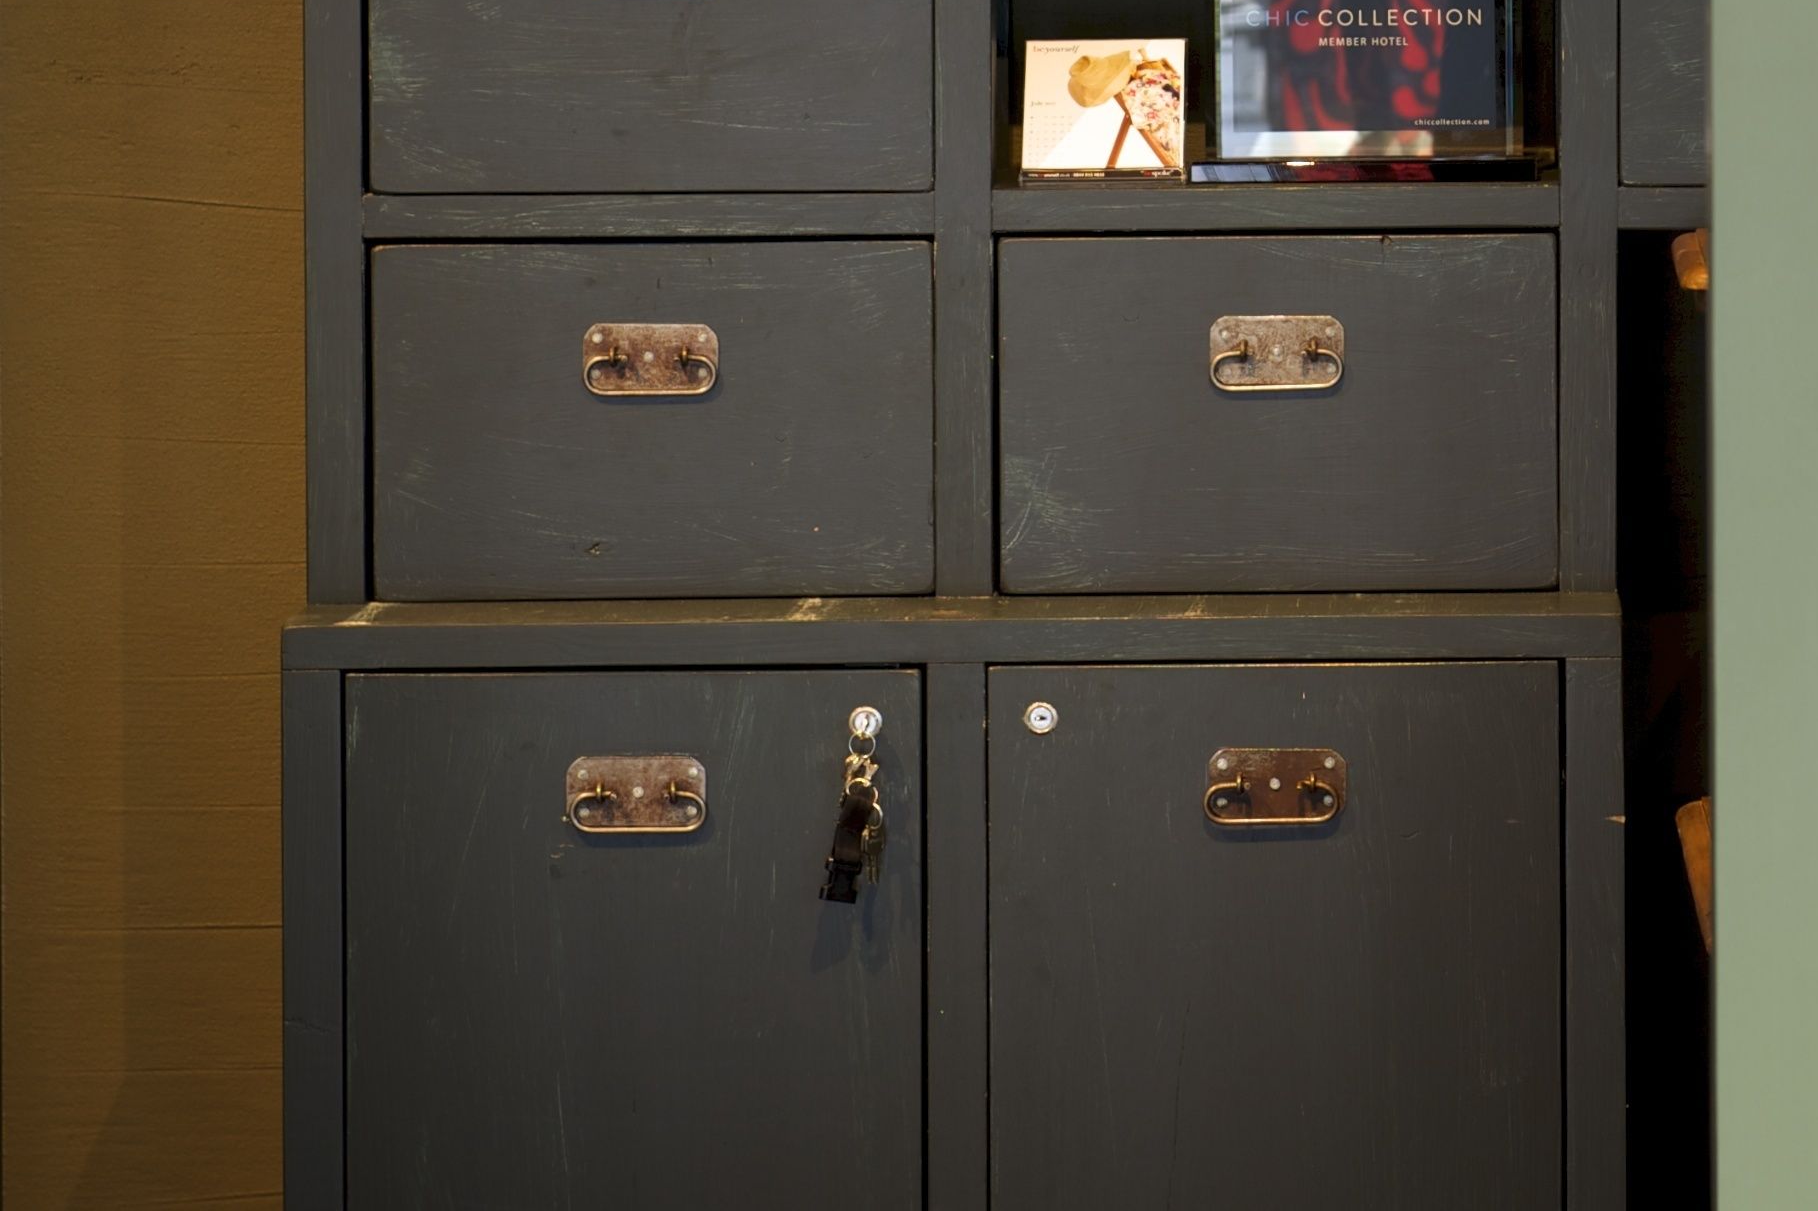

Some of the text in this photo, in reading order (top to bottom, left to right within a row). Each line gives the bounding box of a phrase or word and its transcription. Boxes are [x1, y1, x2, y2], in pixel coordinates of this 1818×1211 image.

[1245, 8, 1483, 28] CHIC COLLECTION
[1318, 36, 1409, 47] MEMBER HOTEL
[1414, 117, 1490, 126] chiccollection.com
